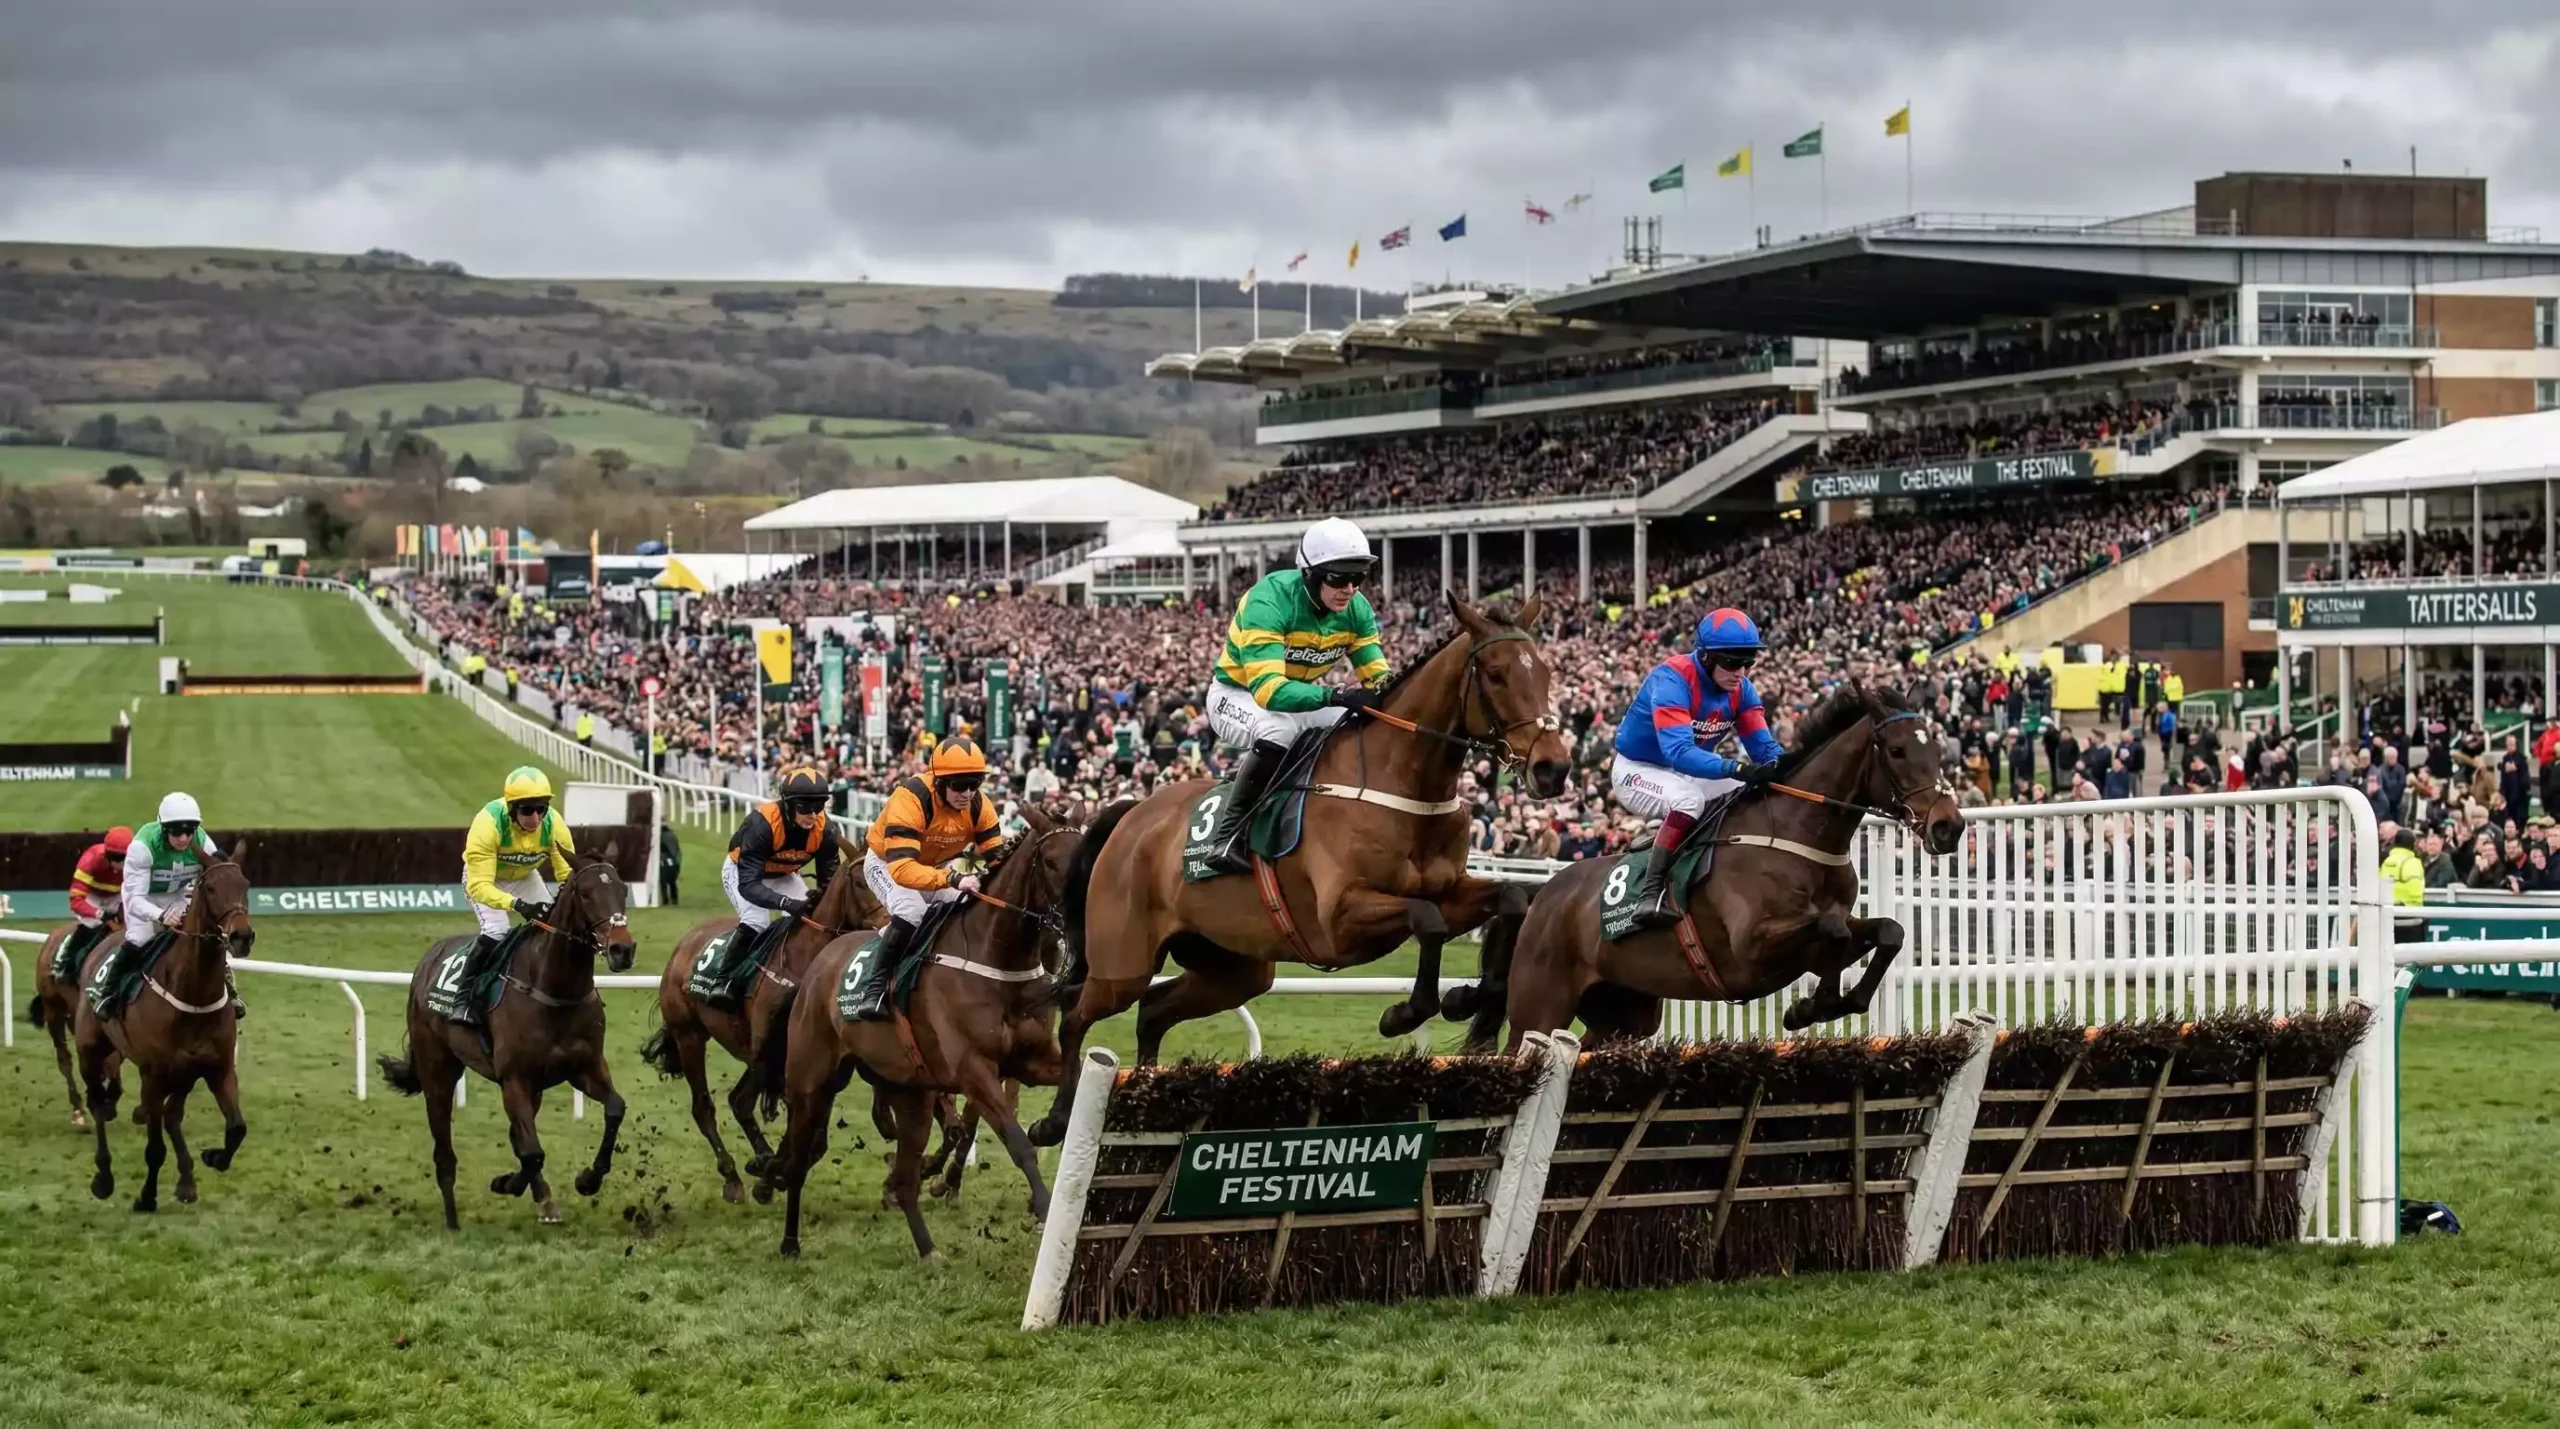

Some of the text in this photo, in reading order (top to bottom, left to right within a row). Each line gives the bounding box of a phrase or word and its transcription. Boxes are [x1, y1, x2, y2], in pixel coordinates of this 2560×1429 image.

[1812, 456, 2076, 498] CHELTENHAM CHELTENHAM THE FESTIVAL
[2306, 597, 2365, 612] CHELTENHAM
[2407, 591, 2537, 623] TATTERSALLS
[1191, 795, 1222, 841] 3
[279, 890, 453, 909] CHELTENHAM
[1604, 864, 1630, 906] 8
[95, 953, 116, 983] 6
[697, 937, 726, 971] 5
[844, 950, 872, 991] 5
[436, 953, 468, 993] 12
[1191, 1133, 1423, 1171] CHELTENHAM
[1219, 1171, 1376, 1204] FESTIVAL
